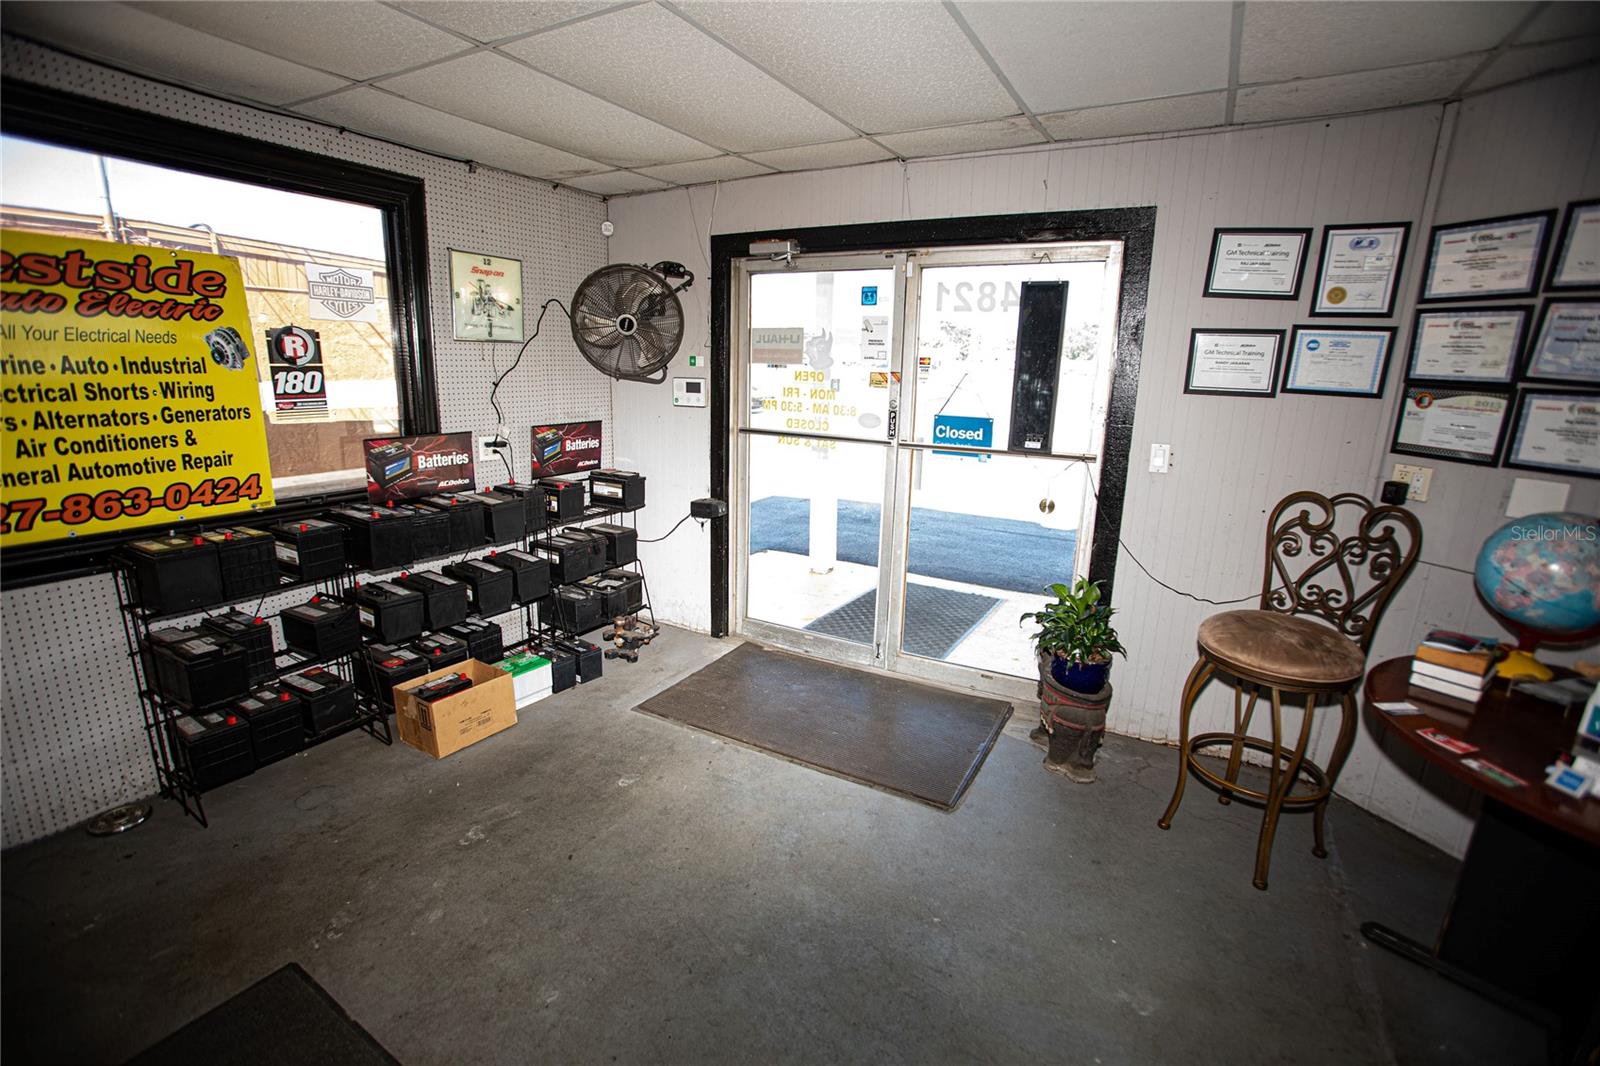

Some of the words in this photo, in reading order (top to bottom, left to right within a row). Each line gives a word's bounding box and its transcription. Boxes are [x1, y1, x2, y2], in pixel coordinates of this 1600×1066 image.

[324, 272, 359, 286] MOTOR
[471, 266, 504, 277] Snap-on
[312, 285, 371, 300] HARLEY-DAVIDSON
[74, 290, 224, 322] Electric
[326, 299, 360, 314] CYCLES
[22, 325, 59, 341] Your
[64, 326, 130, 343] Electrical
[135, 329, 177, 344] Needs
[283, 335, 306, 357] R
[1242, 350, 1265, 358] Training
[0, 354, 46, 375] rine
[60, 355, 110, 375] Auto
[121, 356, 207, 375] Industrial
[0, 382, 77, 403] ctrical
[83, 382, 150, 402] Shorts
[158, 381, 215, 402] Wiring
[274, 370, 323, 395] 180
[33, 408, 151, 431] Alternators
[160, 405, 251, 425] Generators
[888, 411, 897, 437] PUSH
[935, 424, 984, 441] Closed
[15, 437, 47, 460] Air
[53, 433, 179, 457] Conditioners
[184, 429, 198, 447] &
[565, 437, 600, 452] Batteries
[0, 463, 60, 489] neral
[67, 456, 177, 483] Automotive
[181, 450, 234, 473] Repair
[417, 451, 469, 469] Batteries
[437, 477, 470, 489] ACDelco
